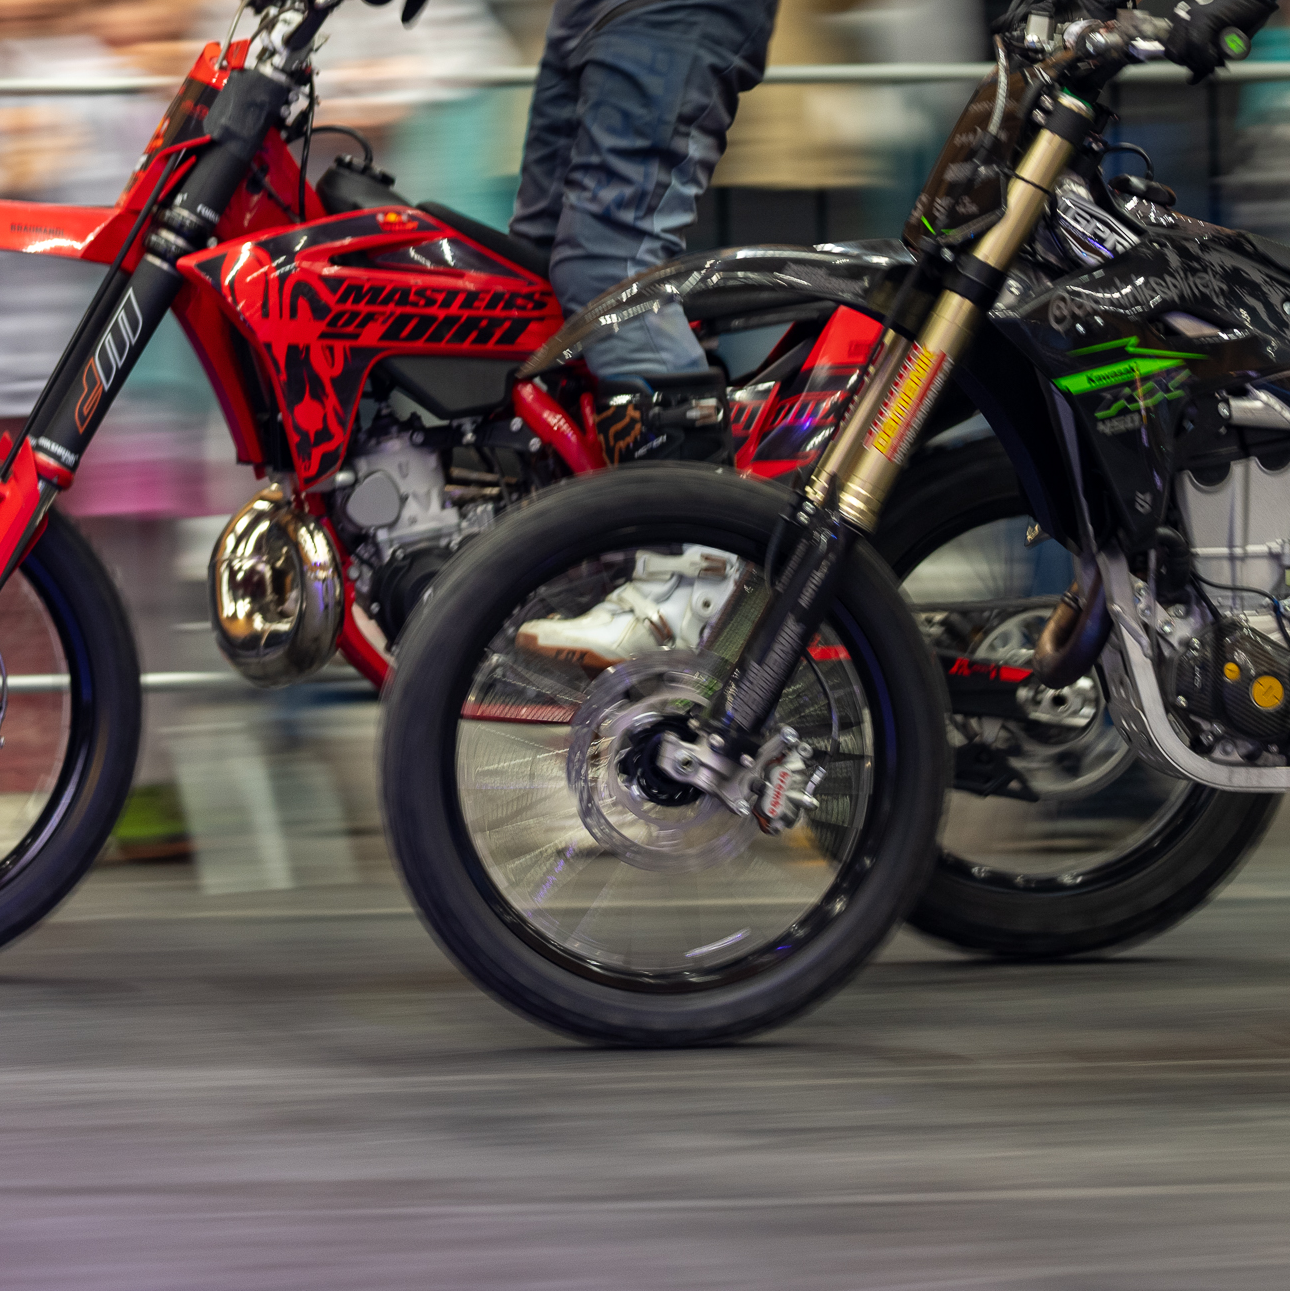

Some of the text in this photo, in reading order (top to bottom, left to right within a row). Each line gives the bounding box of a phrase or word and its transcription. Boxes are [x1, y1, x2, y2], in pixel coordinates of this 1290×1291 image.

[335, 281, 553, 311] MASTERS
[378, 312, 547, 346] DIRT
[553, 649, 589, 664] FOX
